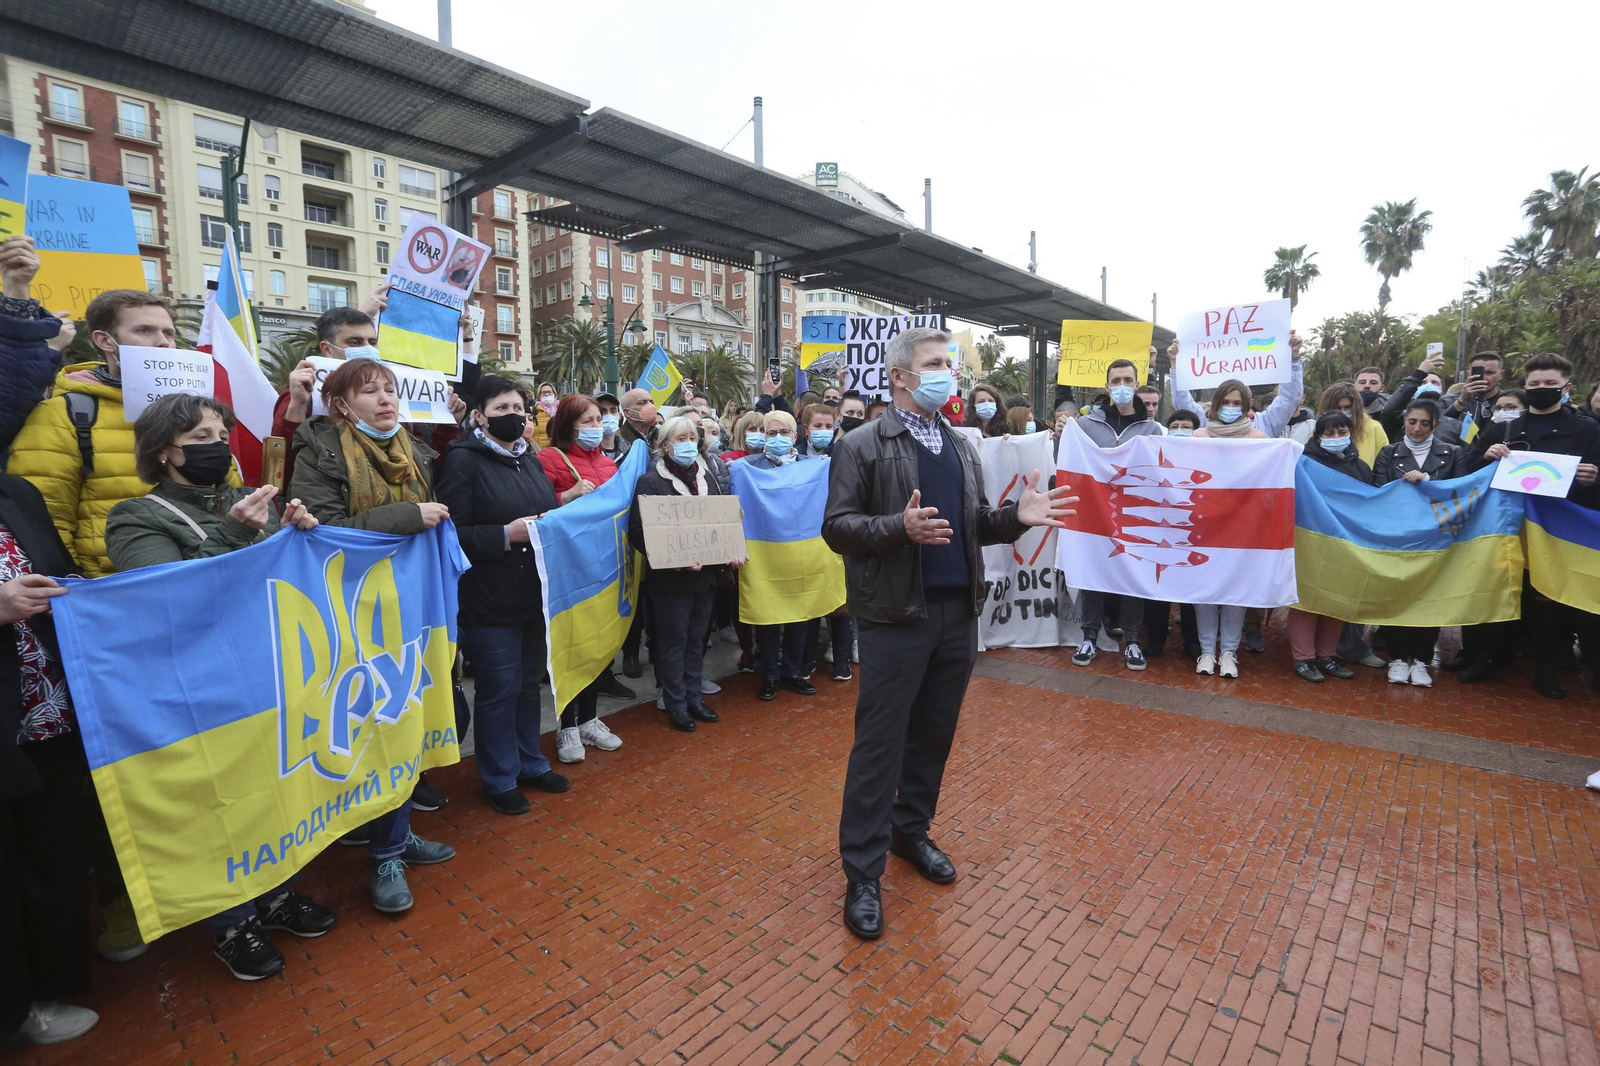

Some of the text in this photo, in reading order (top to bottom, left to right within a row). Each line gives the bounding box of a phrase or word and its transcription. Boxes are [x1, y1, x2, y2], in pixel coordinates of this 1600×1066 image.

[819, 164, 836, 175] AC
[77, 206, 95, 223] IN
[29, 229, 90, 249] KRAINE
[416, 239, 441, 261] WAR
[389, 274, 464, 310] СЛАВА УКРАЇНІ
[259, 314, 286, 324] Banco
[810, 321, 846, 339] STO
[1205, 305, 1264, 337] PAZ
[1061, 334, 1119, 357] #STOP
[1196, 337, 1239, 357] PARA
[143, 360, 209, 374] STOP THE WAR
[1190, 354, 1277, 377] UCRANIA
[155, 377, 206, 389] STOP PUTIN
[397, 377, 446, 403] WAR
[657, 500, 708, 525] STOP
[985, 576, 1011, 603] TOP
[226, 769, 382, 883] НАРОДНИЙ
